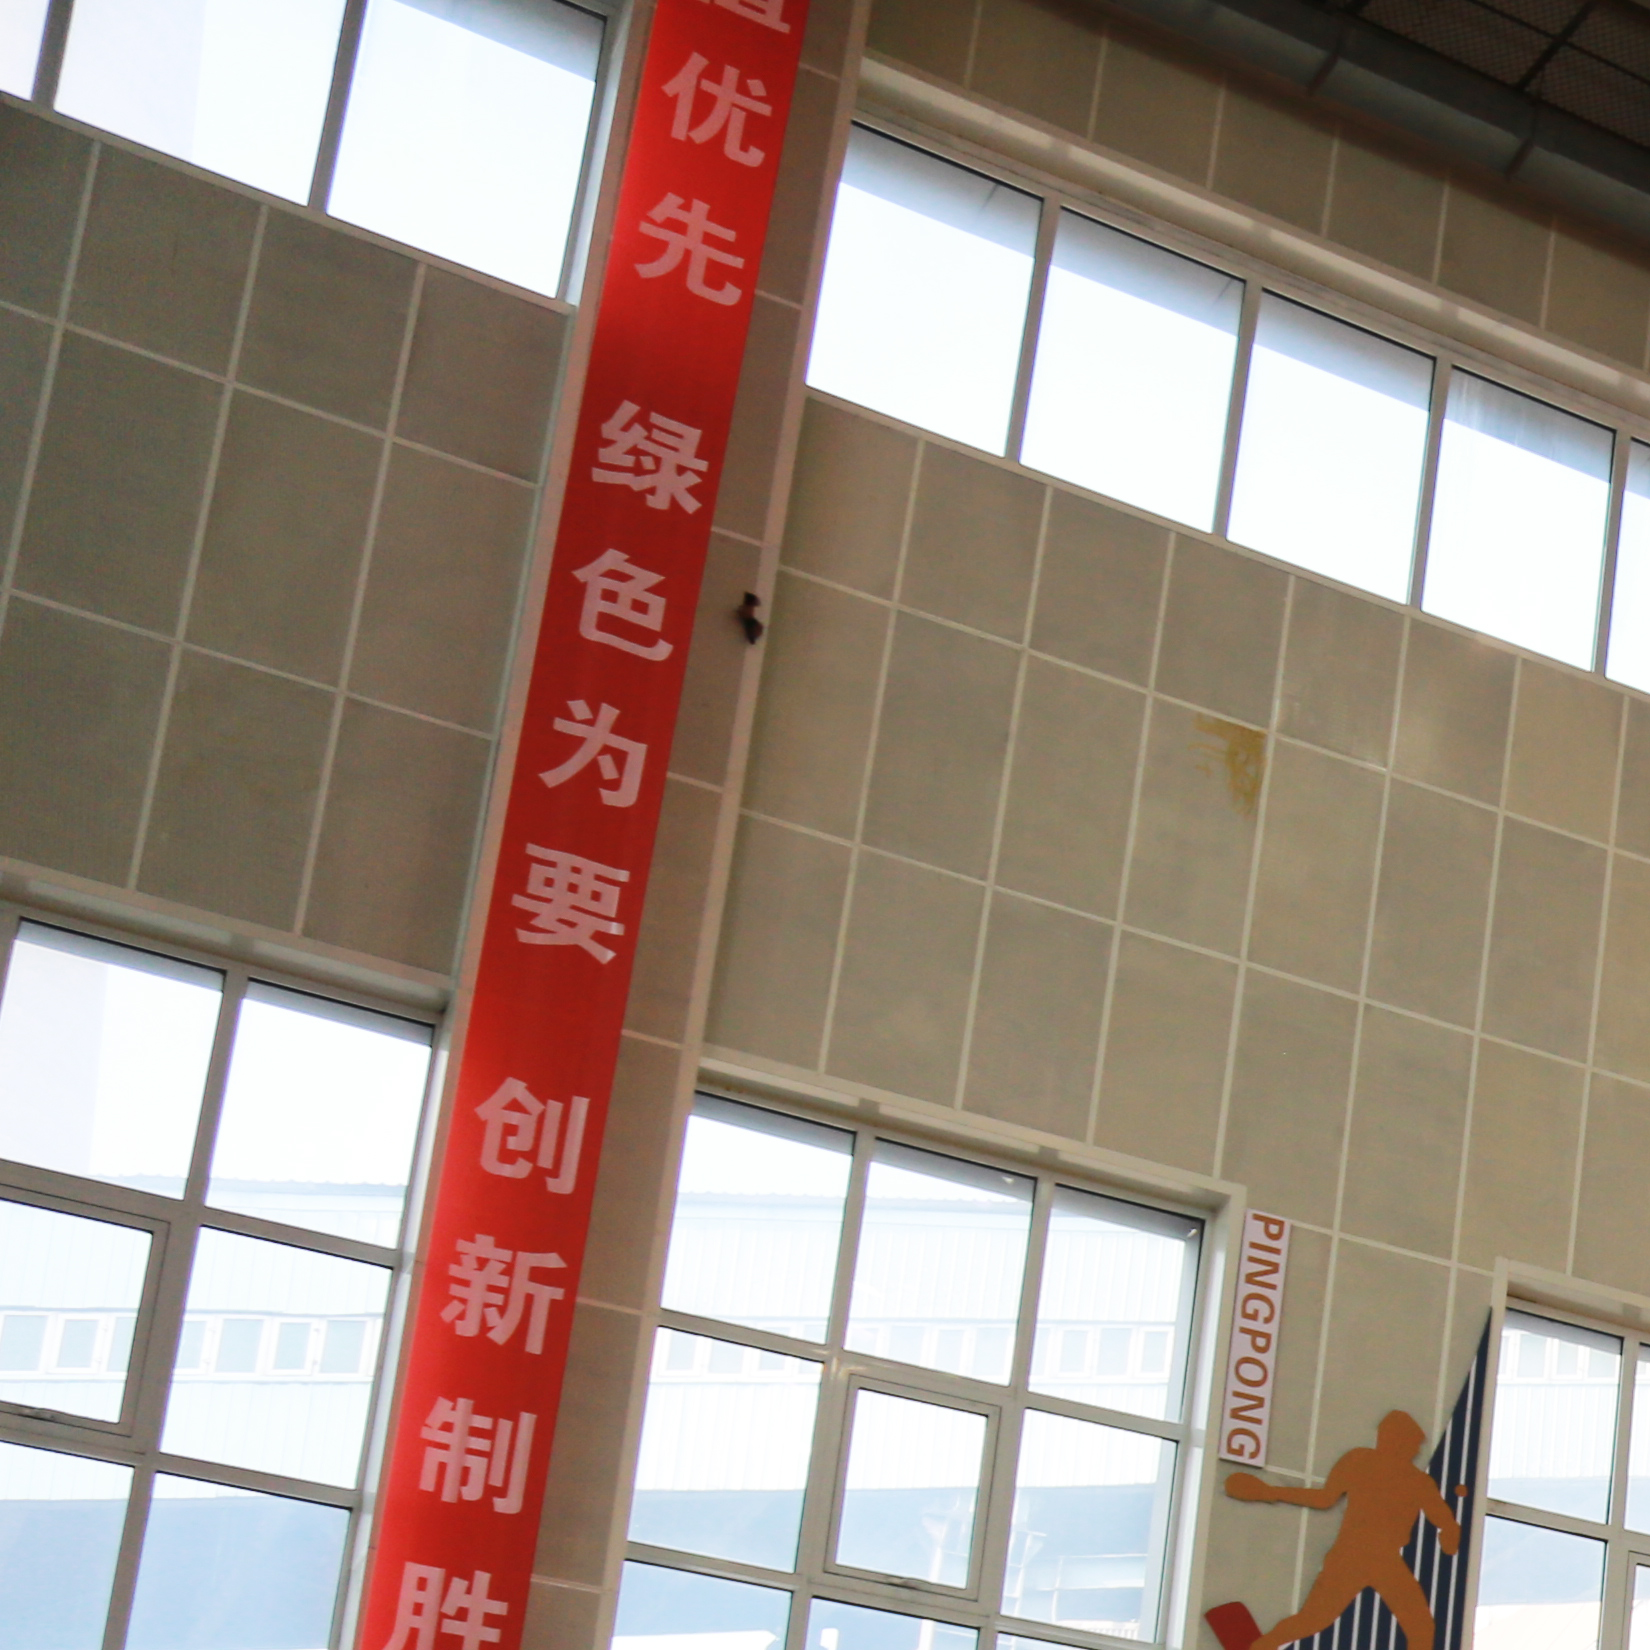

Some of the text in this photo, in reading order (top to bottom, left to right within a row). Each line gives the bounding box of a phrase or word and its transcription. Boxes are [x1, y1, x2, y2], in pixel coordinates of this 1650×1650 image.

[511, 400, 712, 965] 绿色为要
[1224, 1211, 1285, 1463] PINGPONG
